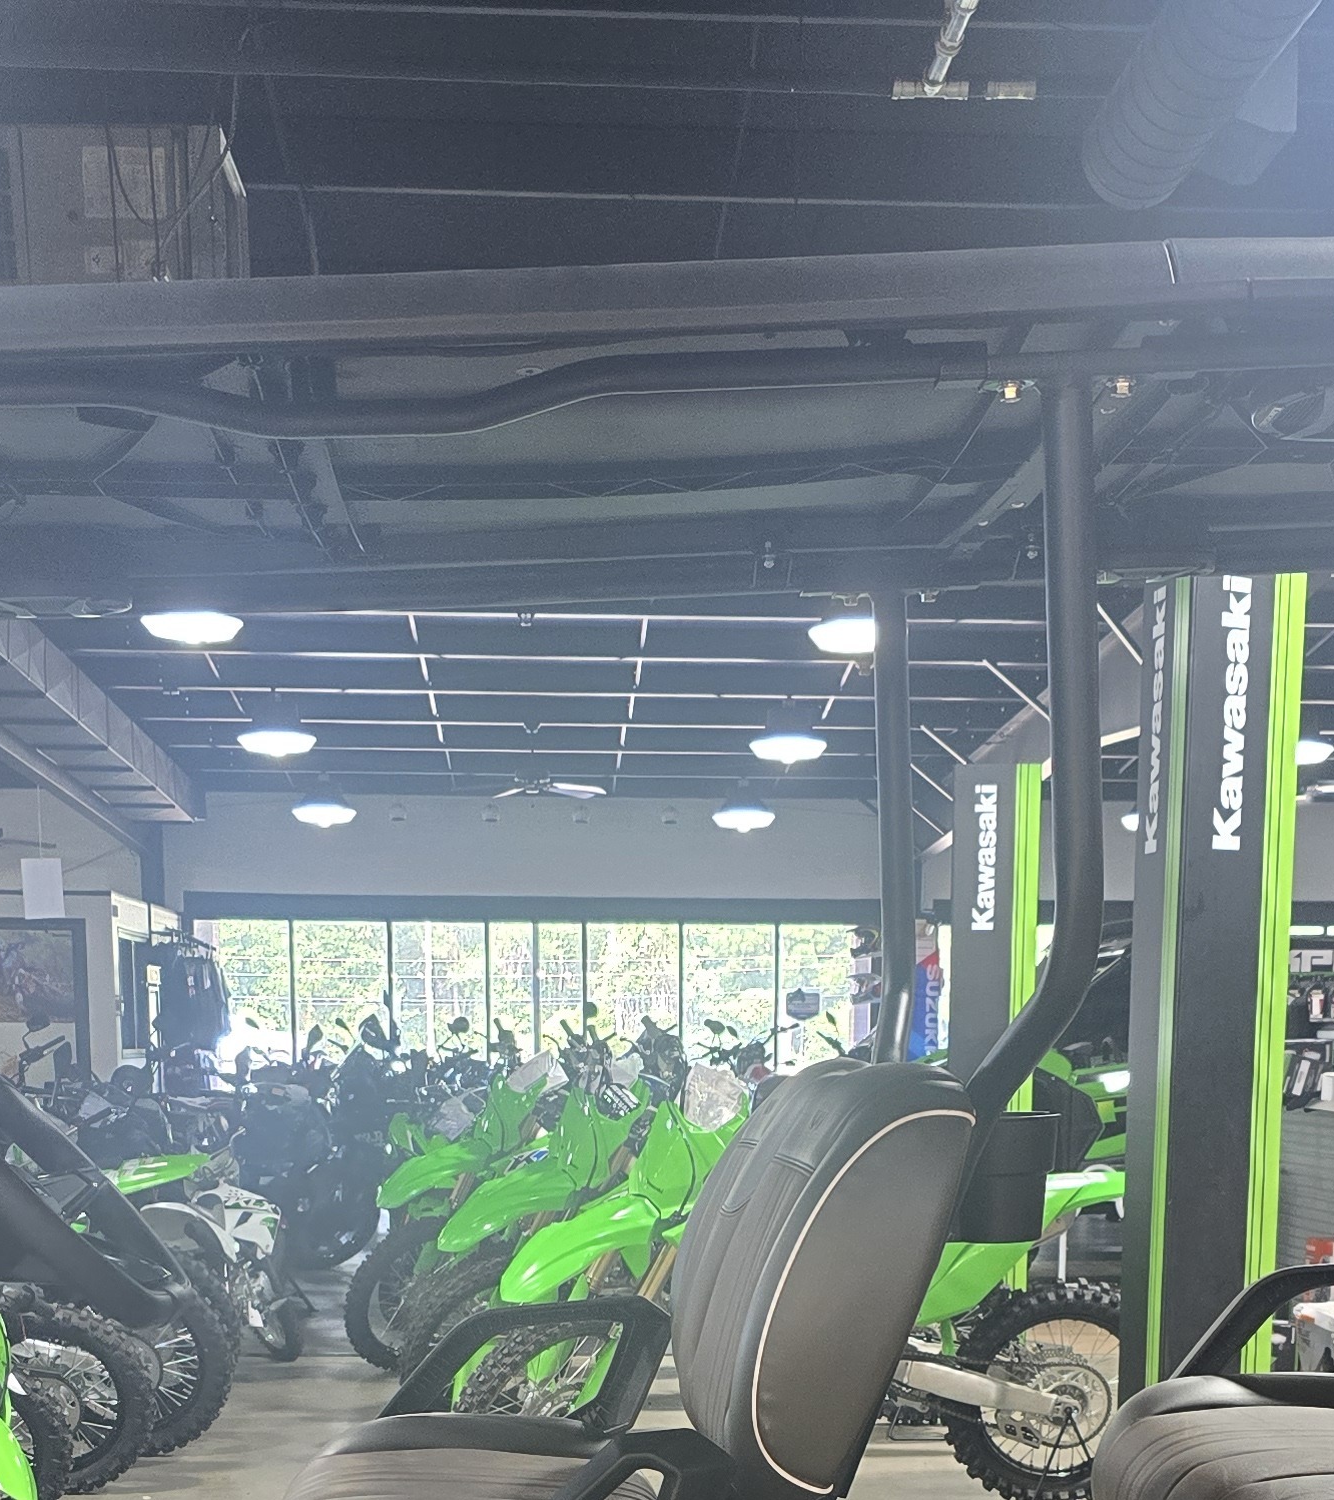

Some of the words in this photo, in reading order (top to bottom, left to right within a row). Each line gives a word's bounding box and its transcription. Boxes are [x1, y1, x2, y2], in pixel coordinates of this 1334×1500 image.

[1142, 585, 1169, 855] Kawasaki
[1211, 575, 1253, 852] Kawasaki
[971, 783, 999, 932] Kawasaki
[924, 963, 941, 1055] SUZUKI
